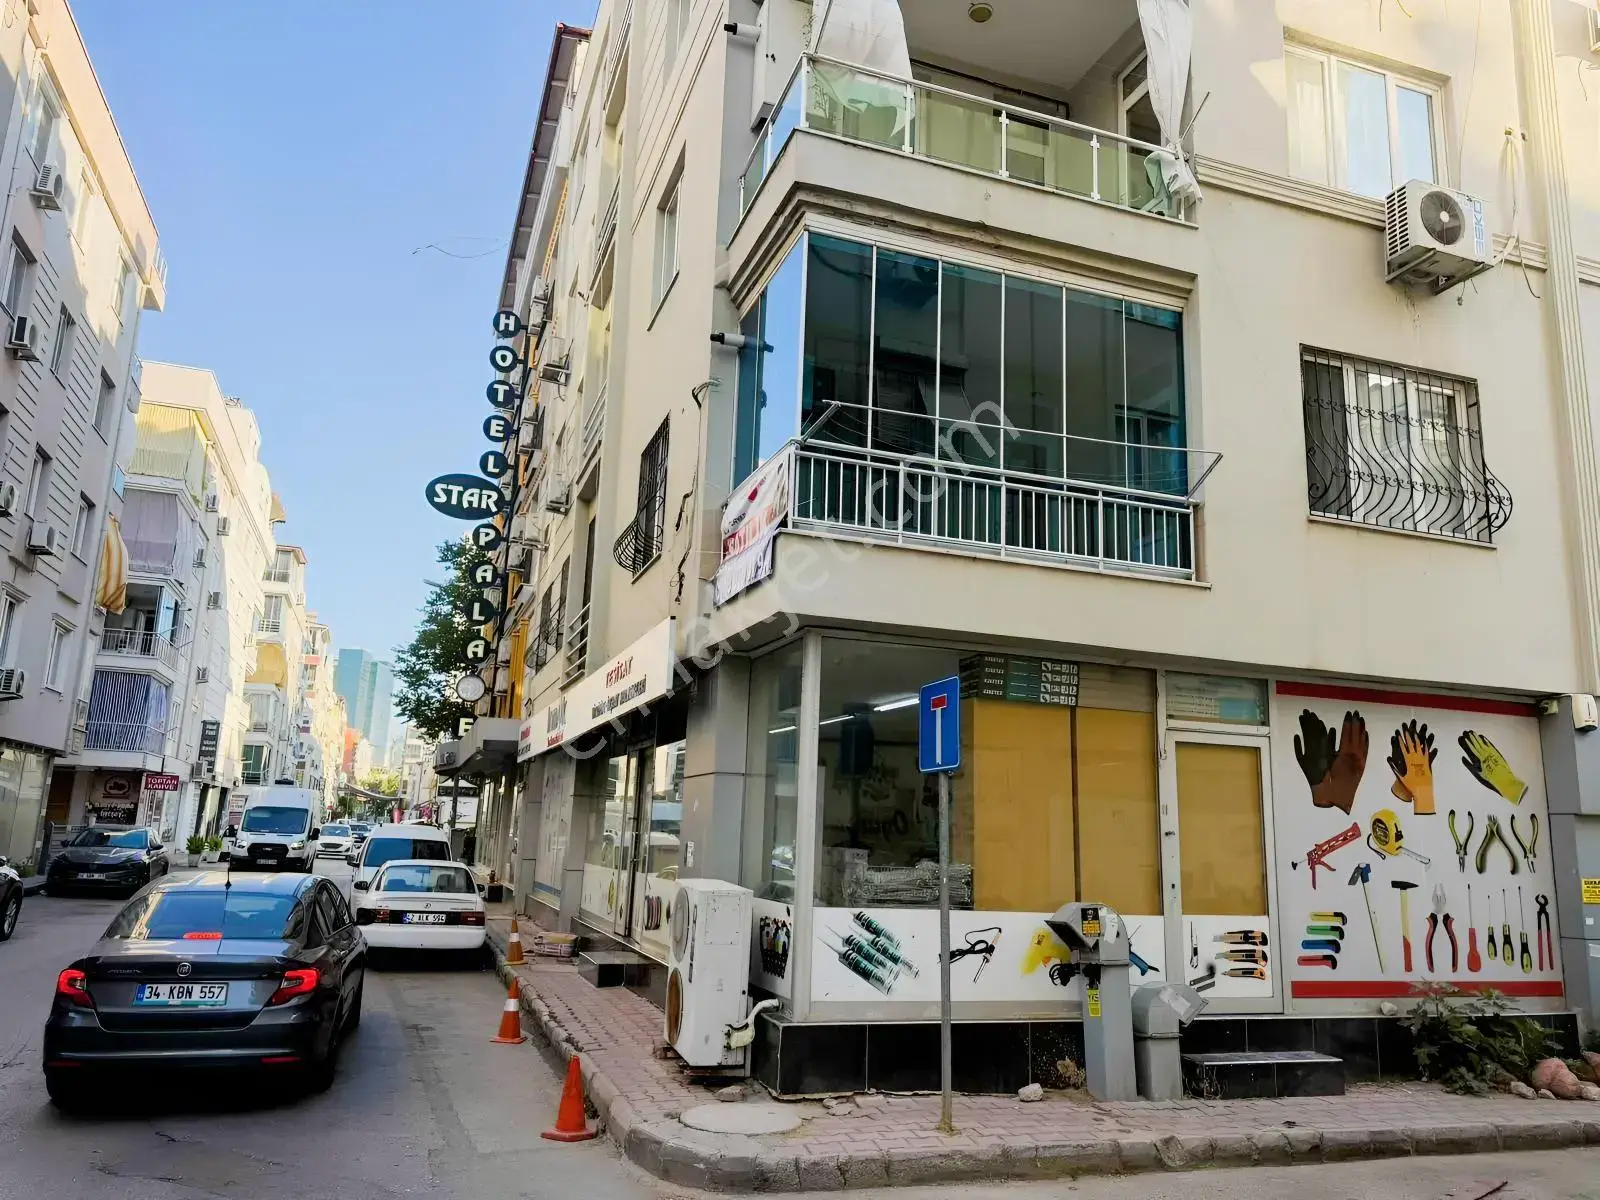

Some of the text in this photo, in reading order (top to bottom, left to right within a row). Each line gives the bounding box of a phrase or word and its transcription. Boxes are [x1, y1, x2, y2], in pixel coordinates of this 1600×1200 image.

[487, 313, 516, 474] HOTEL
[433, 483, 499, 512] STAR
[147, 777, 177, 785] TOPTAN
[145, 985, 225, 999] 34 KBN 557
